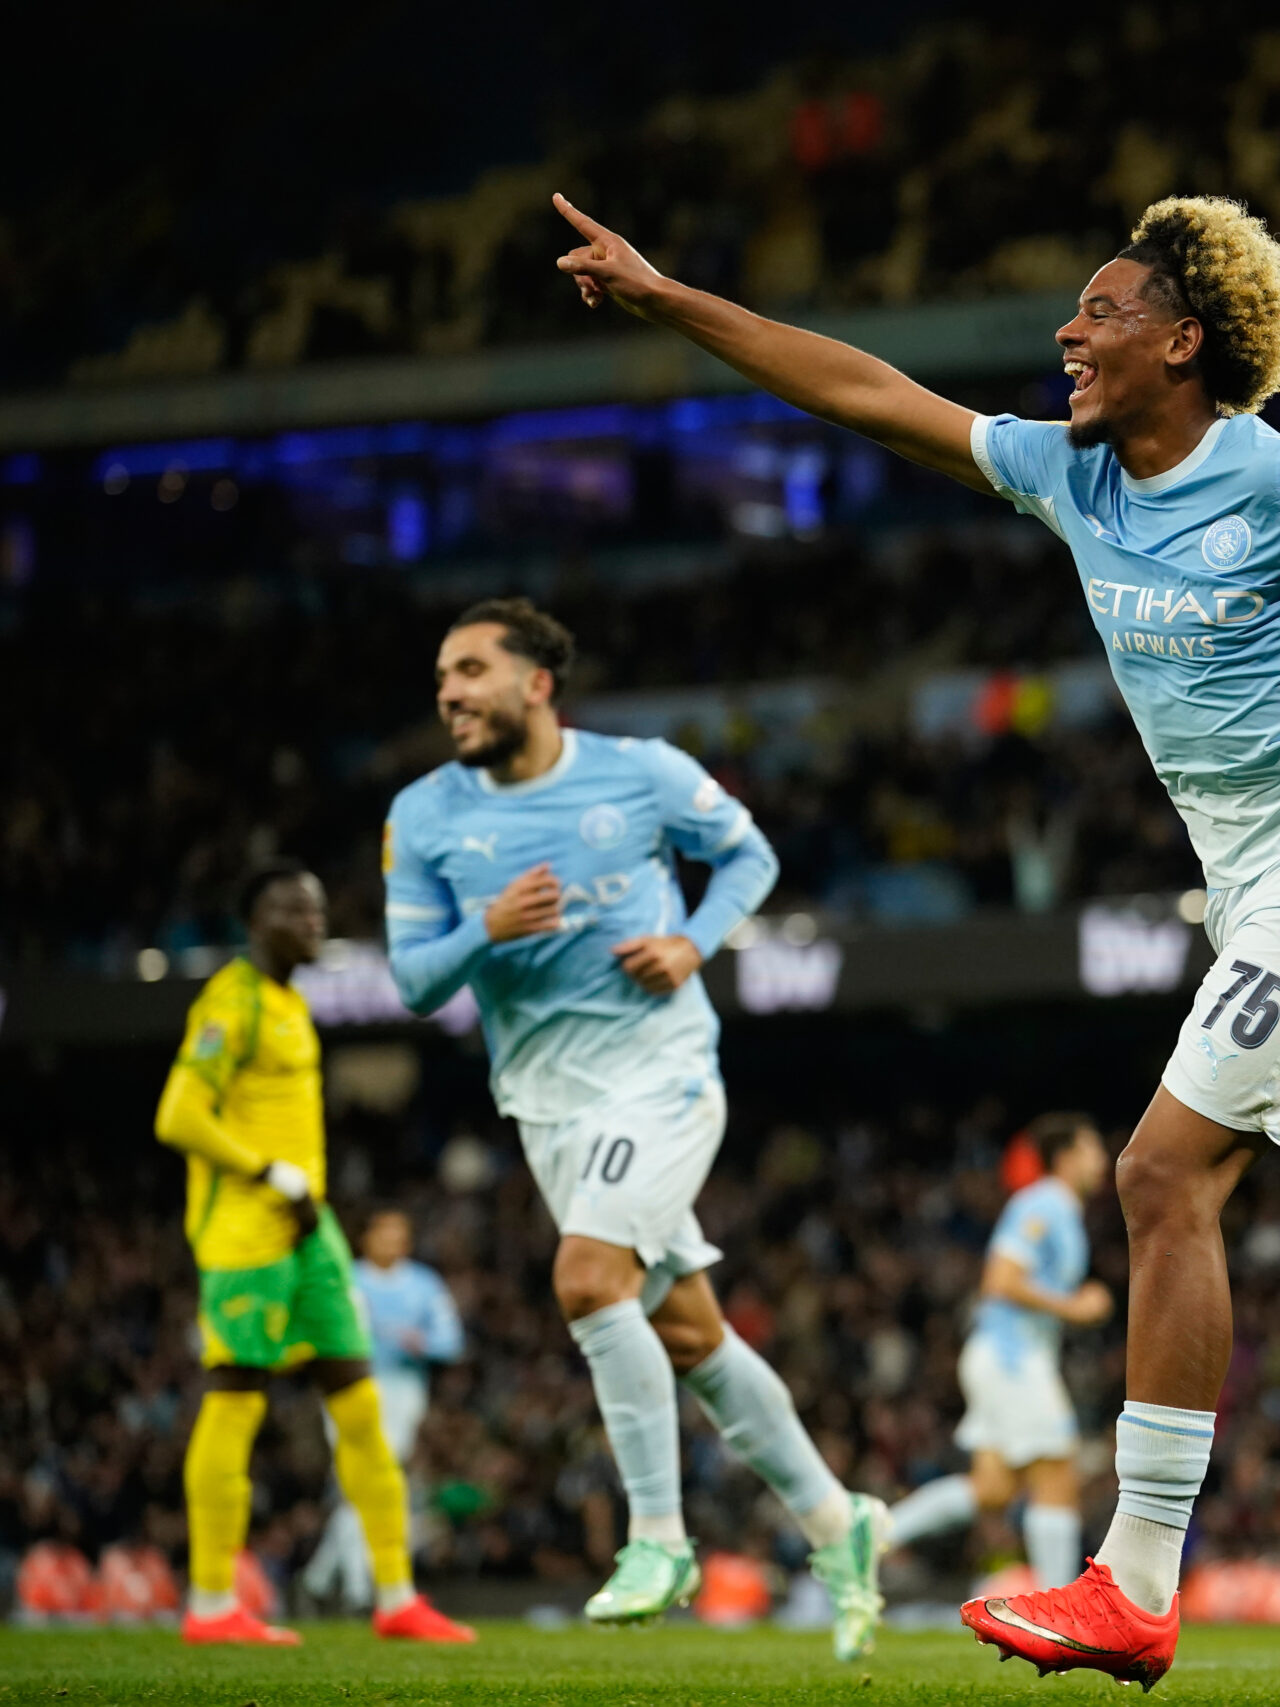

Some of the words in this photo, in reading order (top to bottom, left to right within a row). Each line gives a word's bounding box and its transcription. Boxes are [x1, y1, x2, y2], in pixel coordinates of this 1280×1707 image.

[1088, 578, 1264, 625] ETIHAD
[1112, 631, 1216, 658] AIRWAYS
[581, 1133, 635, 1184] 10
